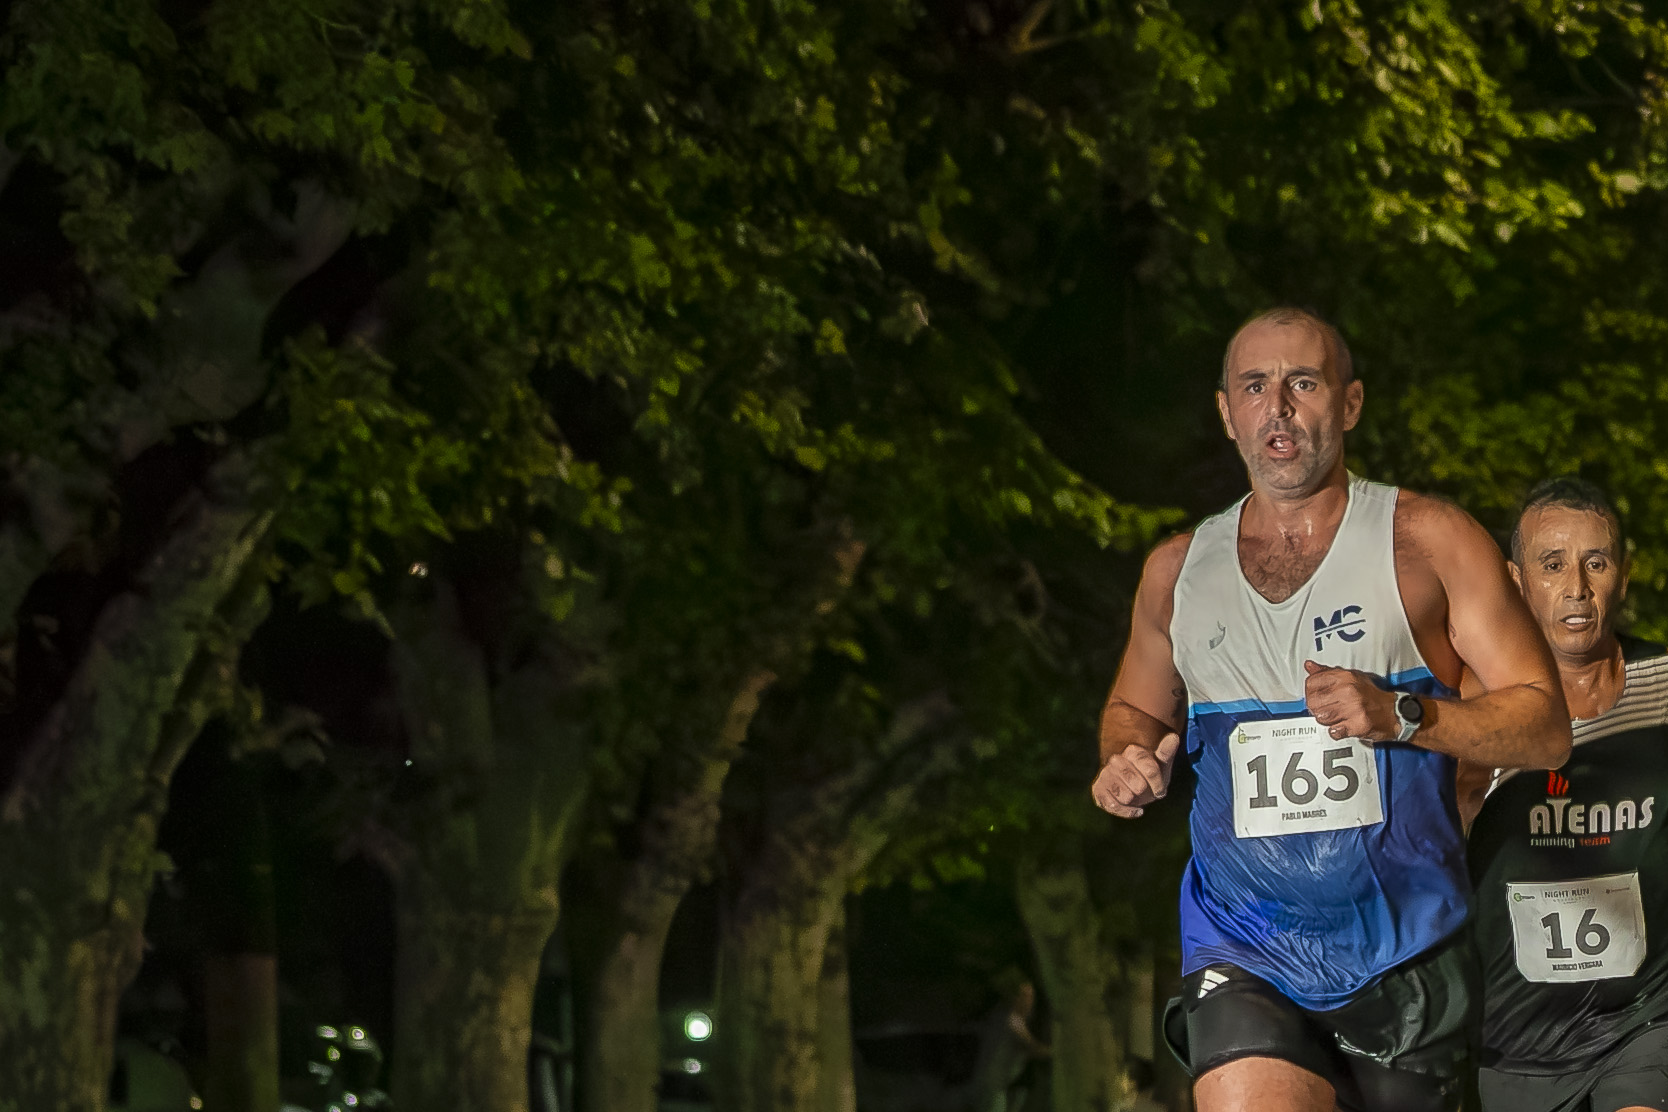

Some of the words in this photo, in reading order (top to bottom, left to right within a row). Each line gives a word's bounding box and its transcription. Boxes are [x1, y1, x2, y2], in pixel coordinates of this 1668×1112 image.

[1313, 605, 1366, 652] MC
[1272, 728, 1296, 738] NIGHT
[1298, 726, 1318, 735] RUN
[1247, 747, 1359, 809] 165
[1281, 811, 1302, 822] PABLO
[1544, 890, 1569, 899] NIGHT
[1571, 888, 1591, 896] RUN
[1541, 908, 1611, 958] 16
